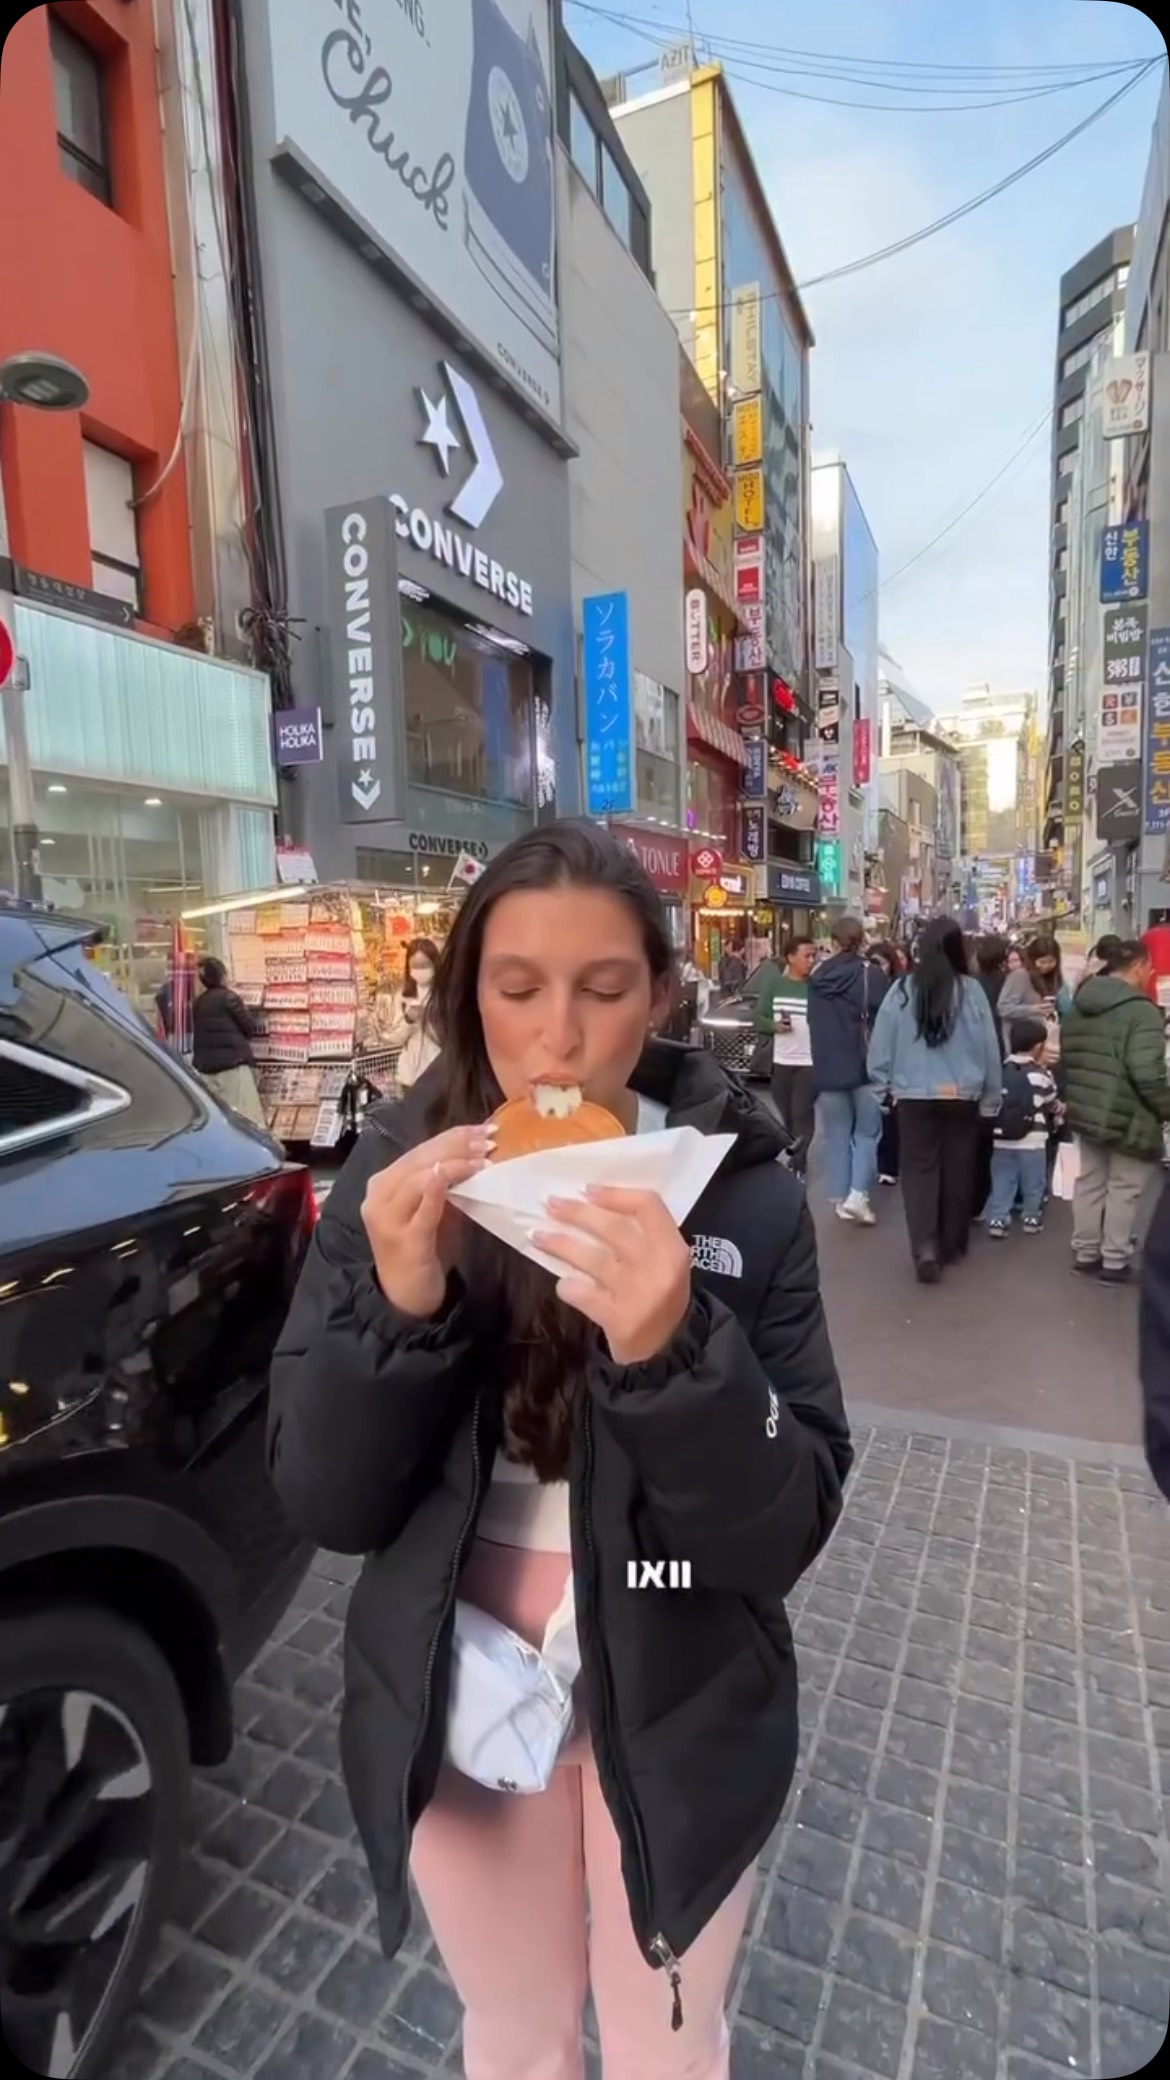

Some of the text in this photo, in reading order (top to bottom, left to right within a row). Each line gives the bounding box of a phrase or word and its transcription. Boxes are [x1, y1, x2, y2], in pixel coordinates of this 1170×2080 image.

[321, 28, 455, 232] Chuck
[388, 494, 533, 616] CONVERSE
[1121, 528, 1140, 586] 부동산
[342, 513, 376, 761] CONVERSE
[690, 600, 701, 660] BUTTER
[595, 602, 620, 733] ソラカバン
[279, 722, 316, 738] HOLIKA
[280, 734, 317, 750] HOLIKA
[408, 832, 477, 857] CONVERSE
[689, 1245, 719, 1261] RTH
[692, 1234, 722, 1248] THE
[689, 1257, 719, 1273] ACE
